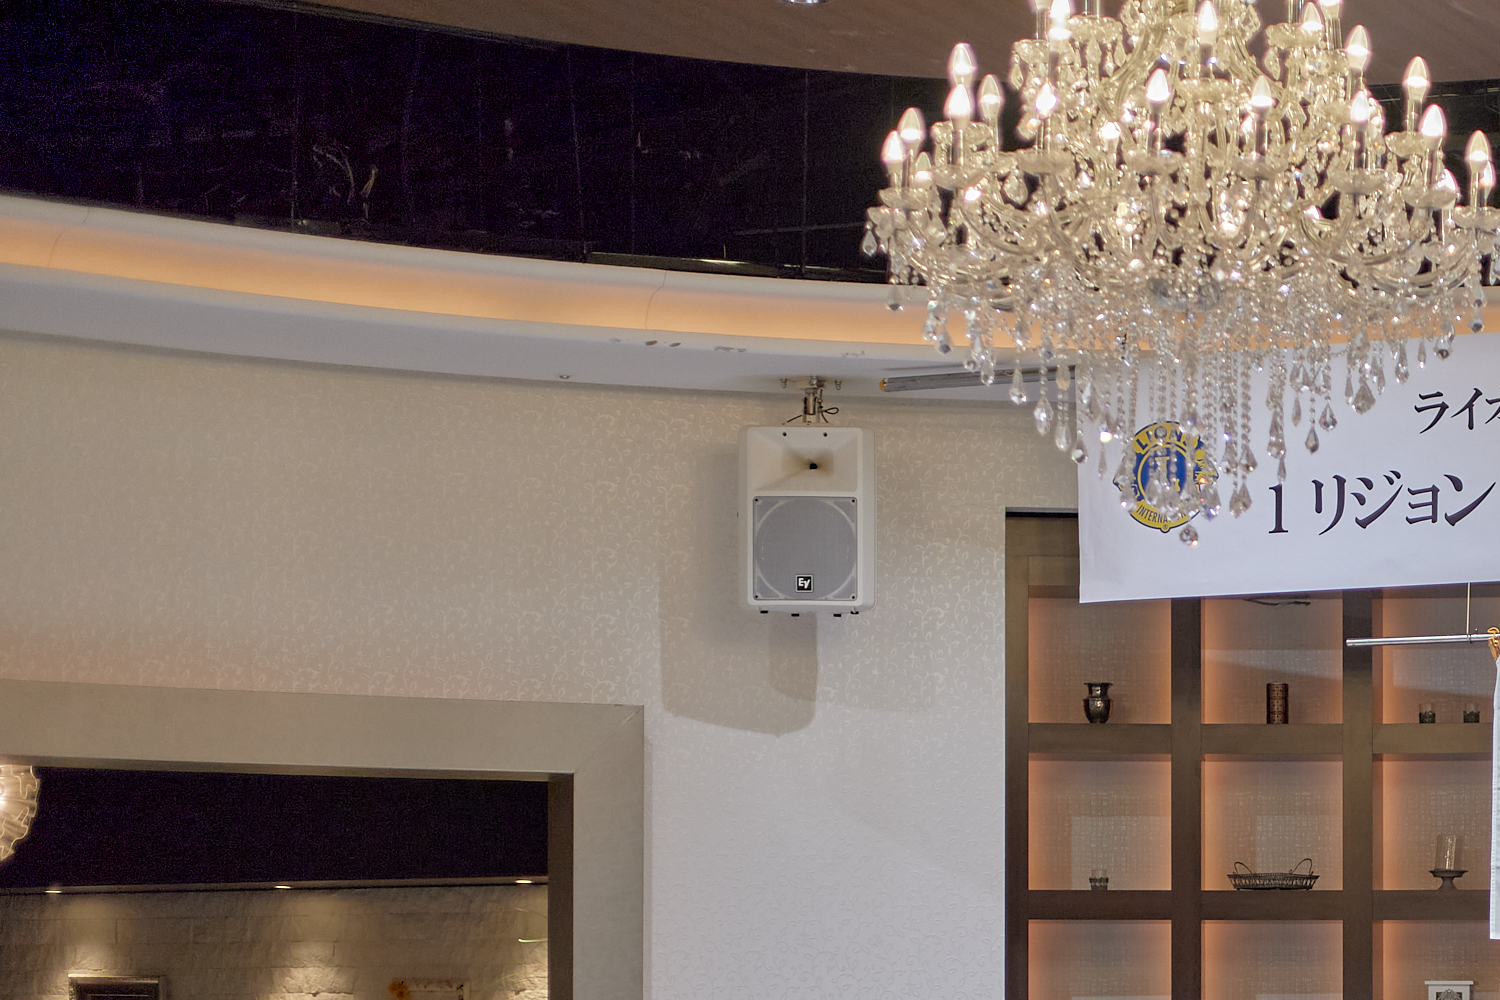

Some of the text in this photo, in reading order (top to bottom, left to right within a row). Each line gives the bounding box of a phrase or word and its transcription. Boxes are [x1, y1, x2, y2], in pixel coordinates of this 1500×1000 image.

[1268, 483, 1289, 534] 1
[1312, 470, 1497, 536] リジョン
[798, 577, 811, 589] EV
